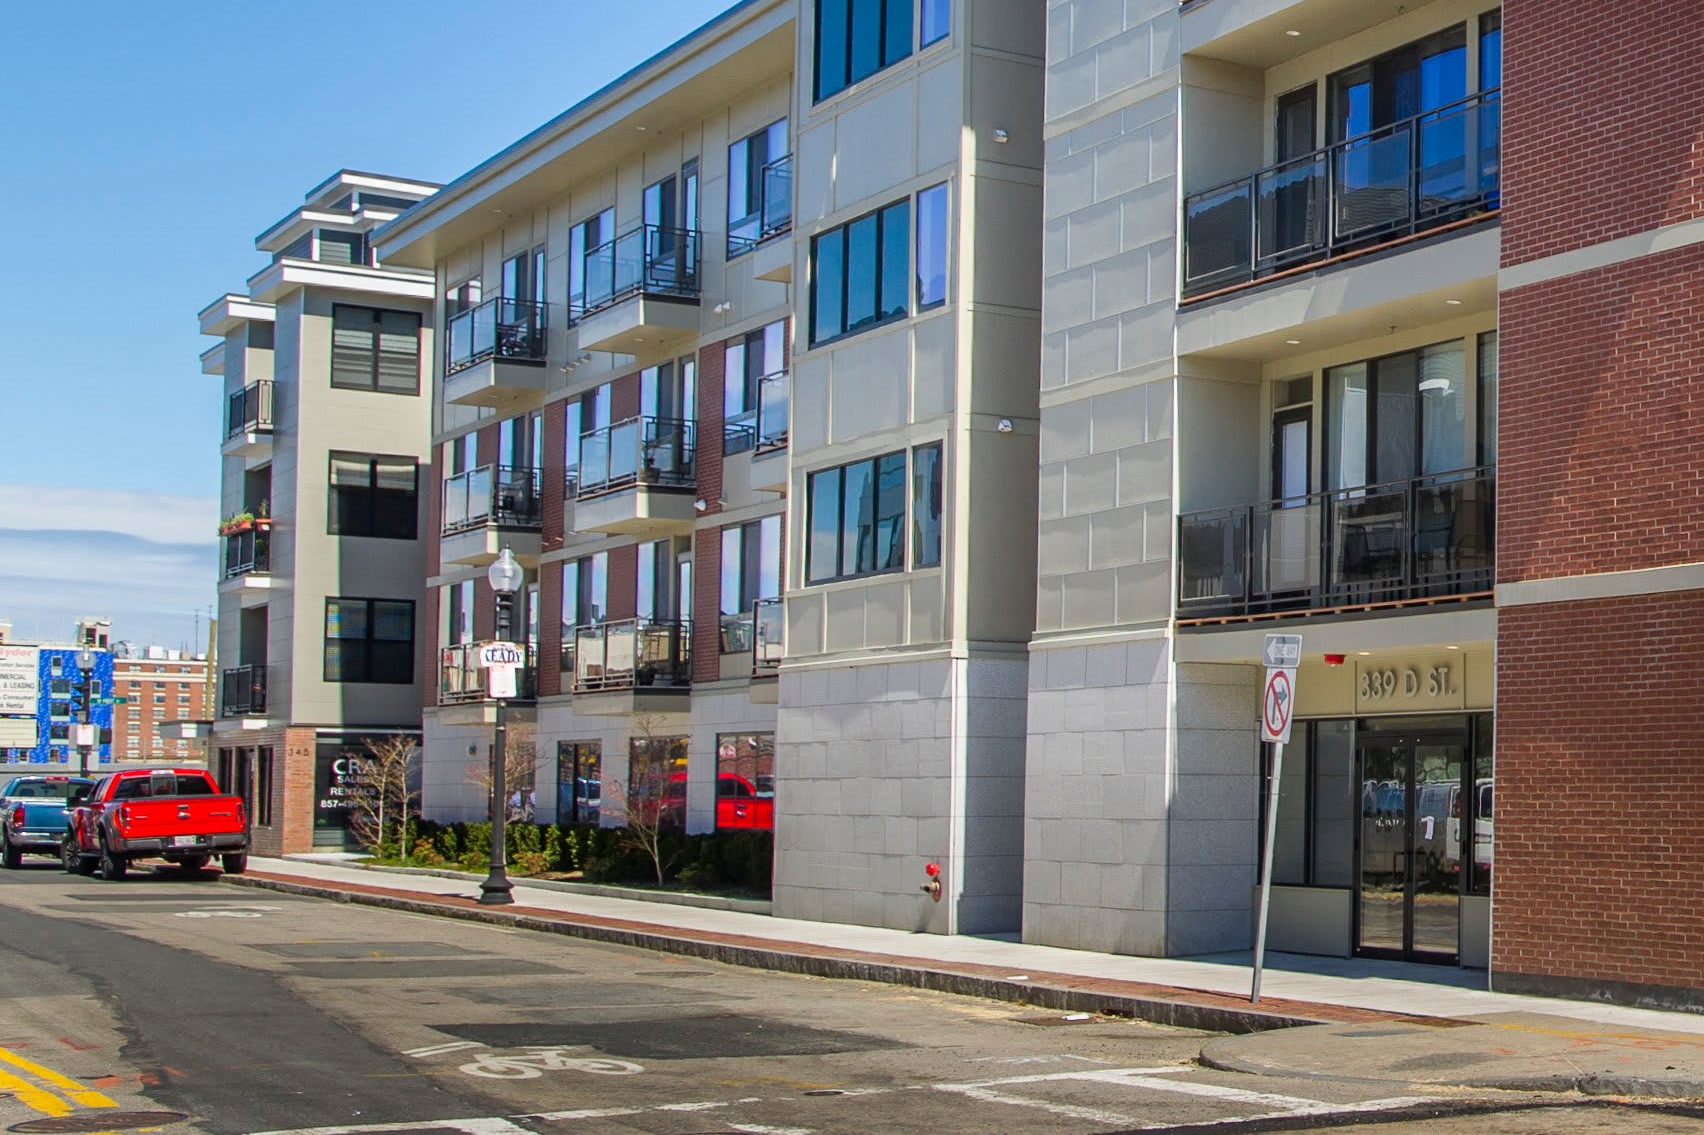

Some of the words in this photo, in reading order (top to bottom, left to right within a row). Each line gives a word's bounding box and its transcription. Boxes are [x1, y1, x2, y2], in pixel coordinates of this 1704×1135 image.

[1360, 670, 1396, 701] 339
[1404, 669, 1418, 698] D
[1428, 667, 1454, 697] ST.
[333, 758, 377, 774] CRA
[330, 786, 377, 796] RENTALS
